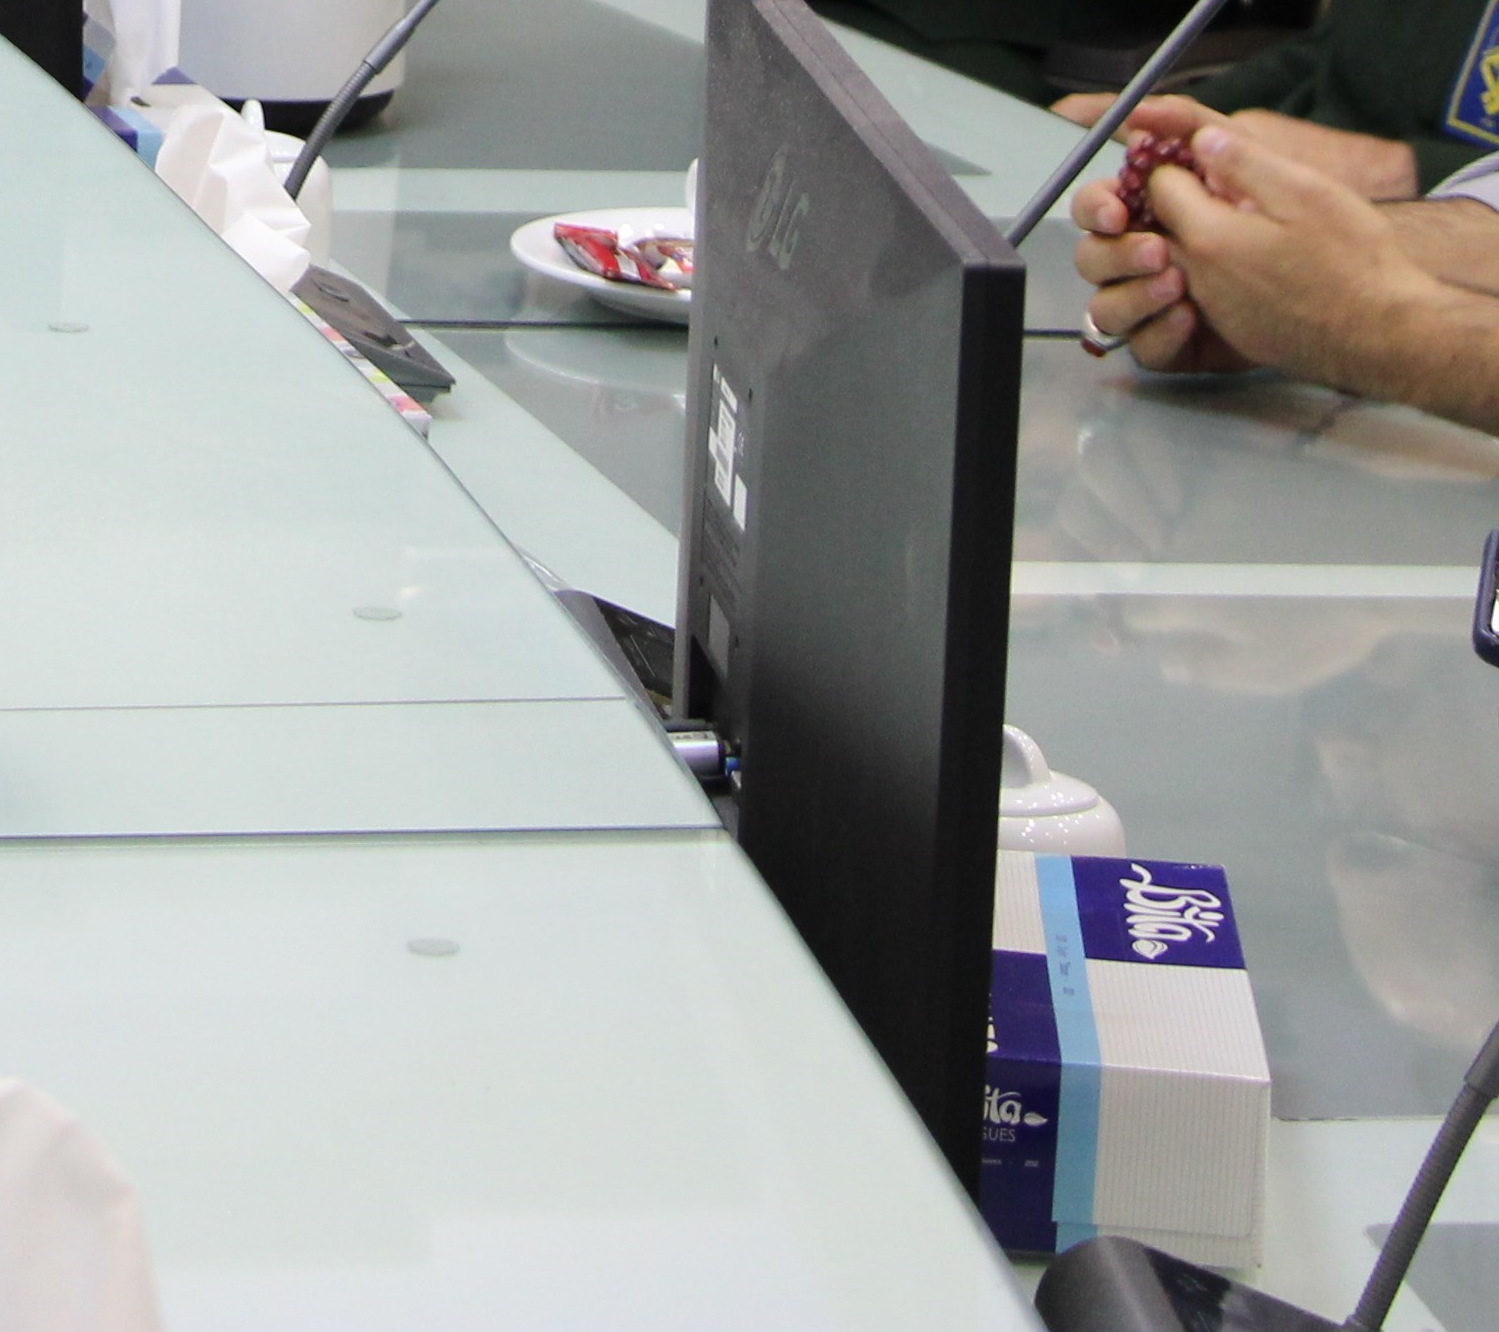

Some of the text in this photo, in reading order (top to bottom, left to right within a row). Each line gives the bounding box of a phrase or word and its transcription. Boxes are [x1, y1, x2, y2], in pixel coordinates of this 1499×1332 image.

[1119, 863, 1225, 944] Bita
[982, 1084, 1022, 1126] ita
[982, 1127, 1017, 1143] SUES
